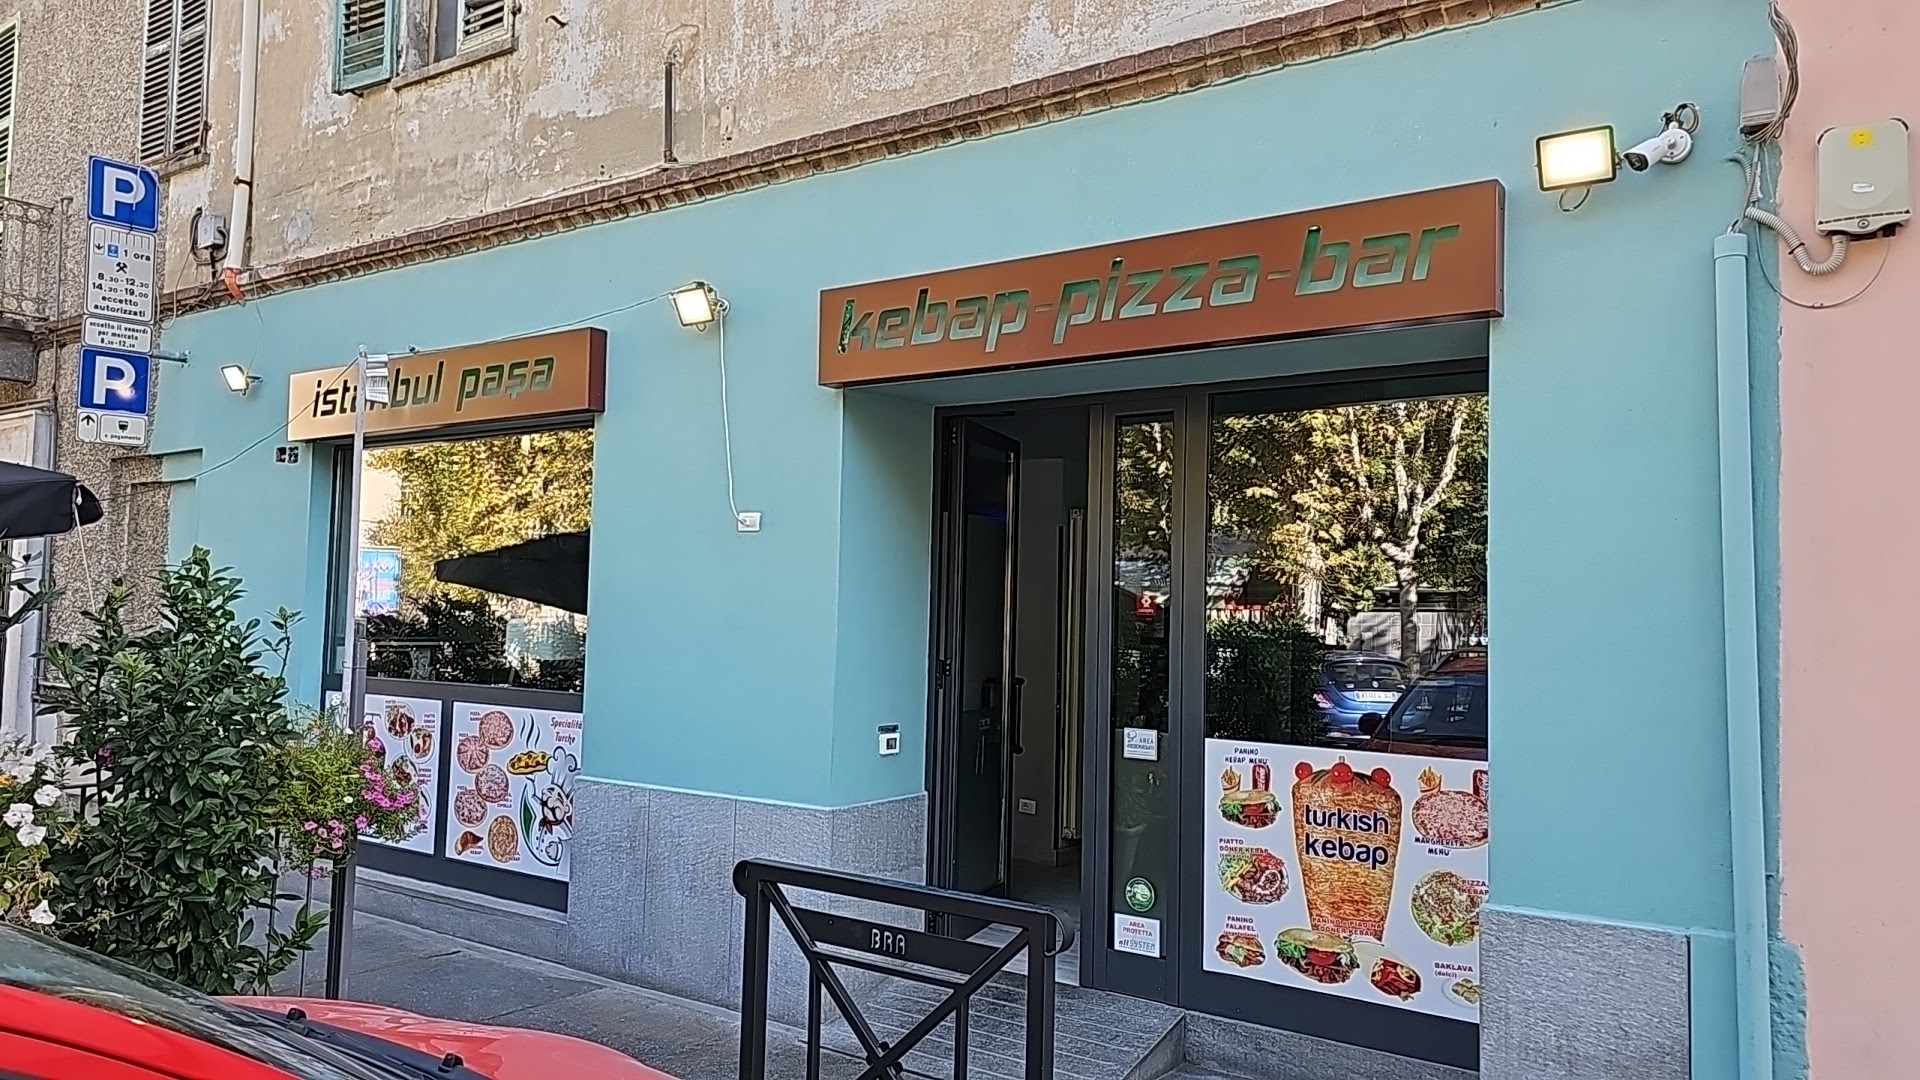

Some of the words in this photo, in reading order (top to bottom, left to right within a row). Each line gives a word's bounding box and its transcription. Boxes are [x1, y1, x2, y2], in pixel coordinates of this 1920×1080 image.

[102, 165, 145, 217] P
[123, 249, 128, 257] 1
[133, 253, 151, 261] ora
[101, 296, 138, 307] eccetto
[94, 304, 145, 317] autorizzati
[93, 355, 136, 405] P
[312, 360, 445, 417] istbul
[555, 732, 575, 745] Turche
[1234, 747, 1258, 755] PANINO
[1305, 804, 1389, 834] turkish
[1414, 836, 1464, 847] MARGHERITA
[1305, 832, 1389, 870] kebap
[1227, 915, 1253, 923] PANINO
[1312, 917, 1340, 925] PANINO
[1122, 927, 1153, 937] PROTETTA
[1226, 923, 1255, 931] FALAFEL
[870, 928, 905, 955] BRA
[1434, 962, 1473, 972] BAKLAVA
